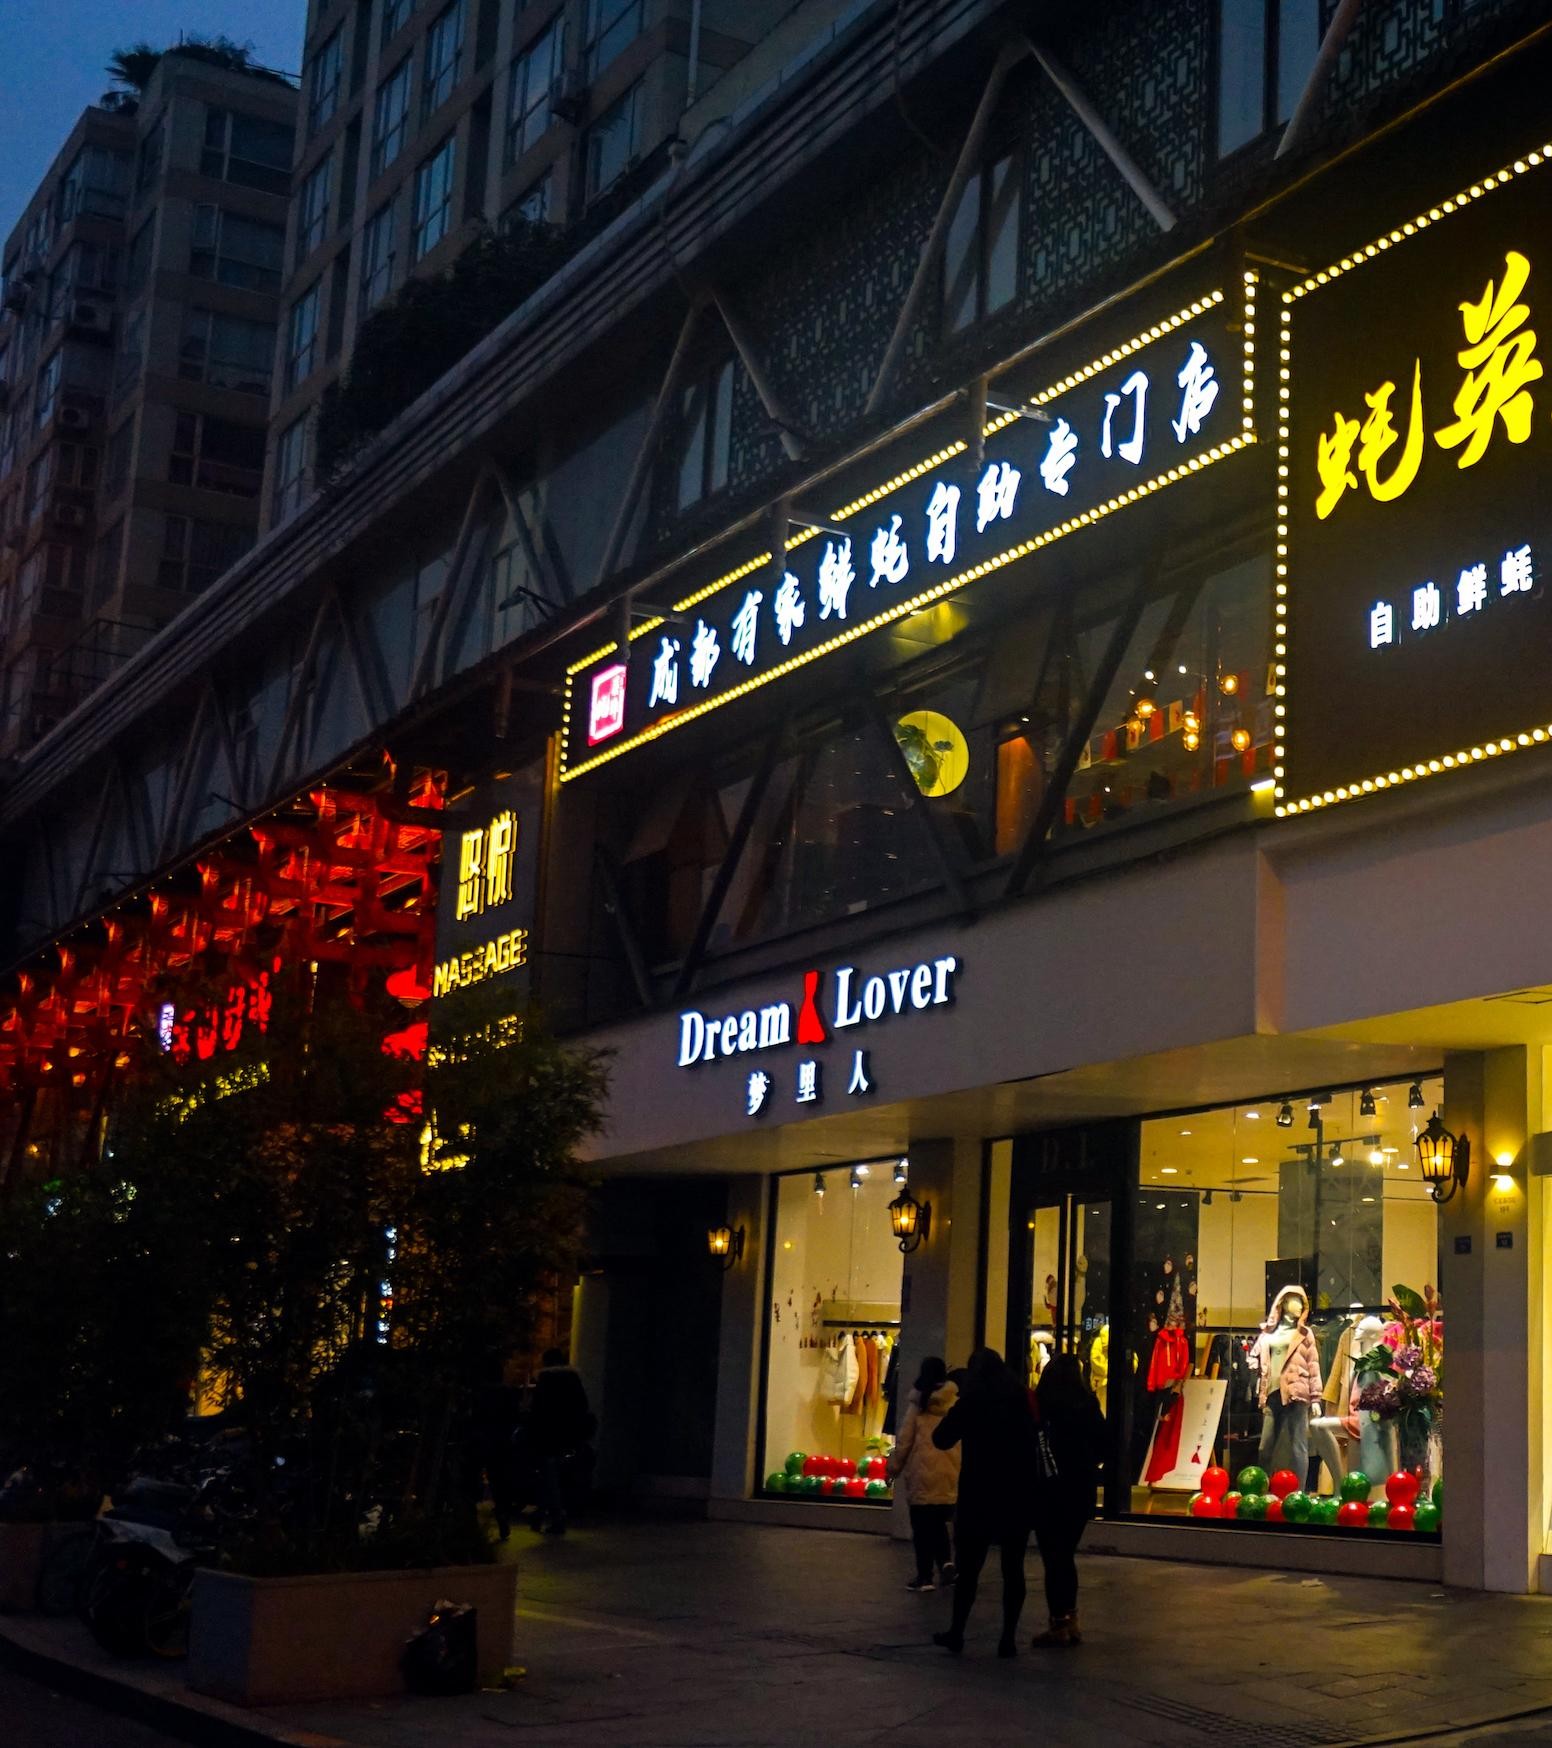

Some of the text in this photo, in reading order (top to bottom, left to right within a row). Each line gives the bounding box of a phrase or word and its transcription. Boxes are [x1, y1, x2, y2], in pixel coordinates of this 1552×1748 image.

[433, 929, 523, 997] MASSAGE
[678, 957, 956, 1067] Dream Lover
[747, 1050, 869, 1115] 梦里人
